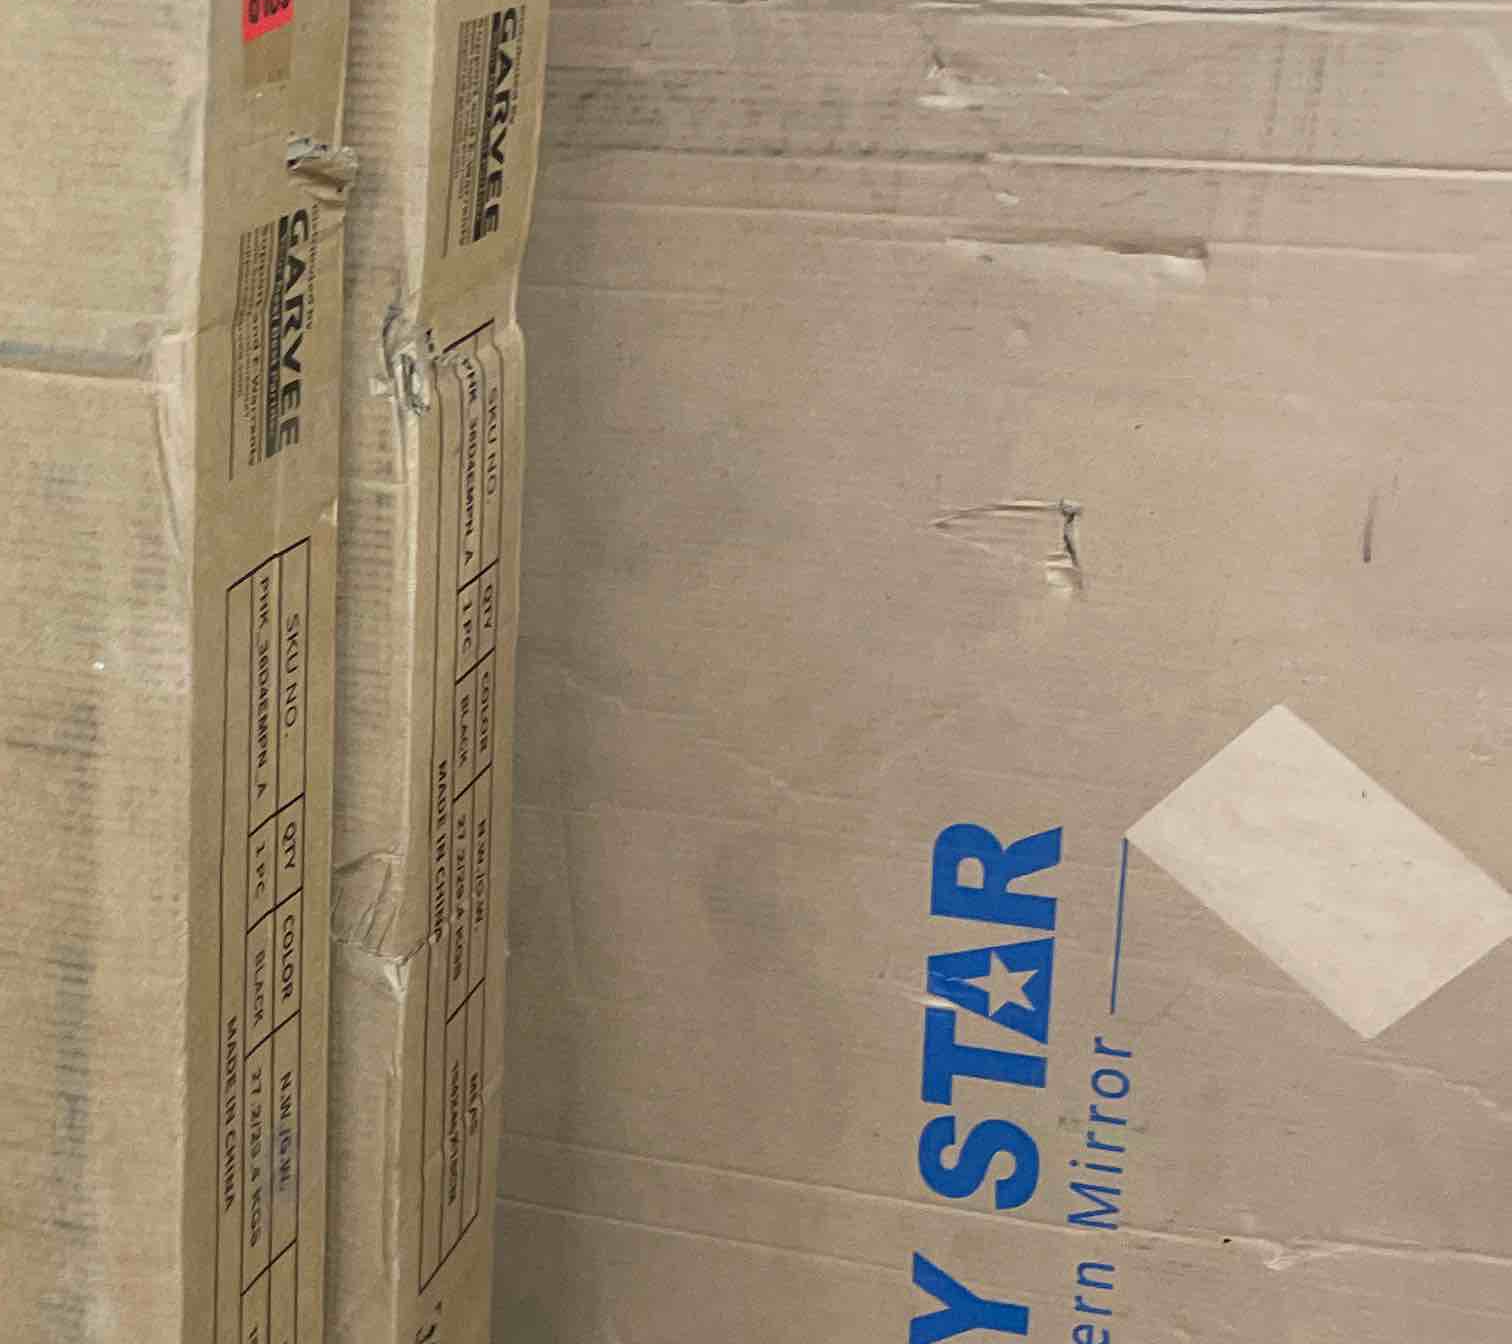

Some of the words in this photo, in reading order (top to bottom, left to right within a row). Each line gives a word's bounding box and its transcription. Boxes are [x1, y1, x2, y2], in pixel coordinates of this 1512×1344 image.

[486, 8, 516, 233] GARVEE
[281, 208, 309, 445] GARVEE
[285, 612, 300, 674] SKU
[283, 821, 298, 873] QTY
[253, 949, 267, 1025] BLACK
[281, 912, 297, 1000] COLOR
[226, 1016, 239, 1091] MADE
[917, 823, 1063, 1210] STAR
[1067, 1035, 1133, 1230] Mirror
